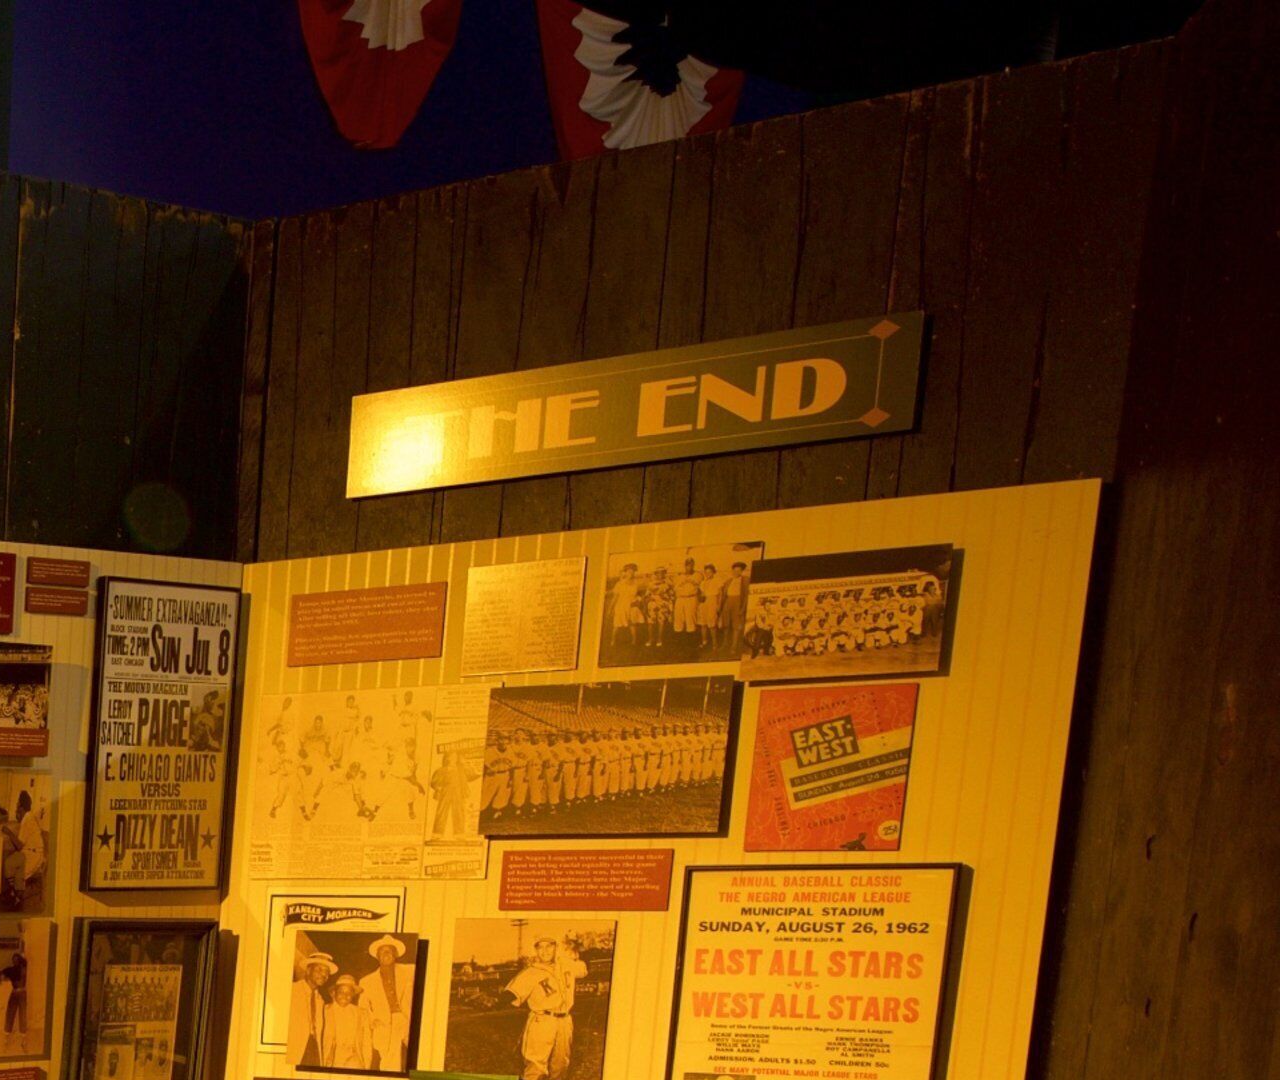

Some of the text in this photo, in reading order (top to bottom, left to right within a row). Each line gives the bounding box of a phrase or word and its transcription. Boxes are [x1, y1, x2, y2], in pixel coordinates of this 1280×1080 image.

[636, 357, 848, 438] END
[112, 594, 153, 622] SUMMER
[155, 598, 228, 628] EXTRAVAGANZA!!
[130, 636, 136, 656] 2
[136, 636, 150, 656] PM
[217, 629, 231, 676] 8
[108, 681, 188, 696] THE MOUND MAGICIAN
[108, 699, 133, 719] LEROY
[136, 697, 191, 748] PAIGE
[101, 720, 136, 746] SATCHEL
[797, 736, 855, 766] WEST
[104, 752, 217, 782] E. CHICAGO GIANTS
[140, 782, 181, 798] VERSUS
[110, 798, 208, 811] LEGENDARY PITCHING STAR
[114, 813, 200, 862] DIZZY DEAN
[131, 851, 179, 871] SPORTSMEN
[730, 875, 902, 888] ANNUAL BASEBALL CLASSIC
[718, 891, 912, 904] THE NEGRO AMERICAN LEAGUE
[288, 904, 322, 916] KANSAS
[301, 912, 325, 923] CITY
[325, 909, 373, 921] MONARCHS
[740, 906, 885, 918] MUNICIPAL STADIUM
[698, 920, 931, 936] SUNDAY, AUGUST 26, 1962
[693, 948, 925, 981] EAST ALL STARS
[691, 991, 921, 1024] WEST ALL STARS
[708, 1055, 872, 1068] ADMISSION: ADULTS $1.50 CHILDREN
[713, 1065, 878, 1080] SEE MANY POTENTIAL MAJOR LEAGUE STARS
